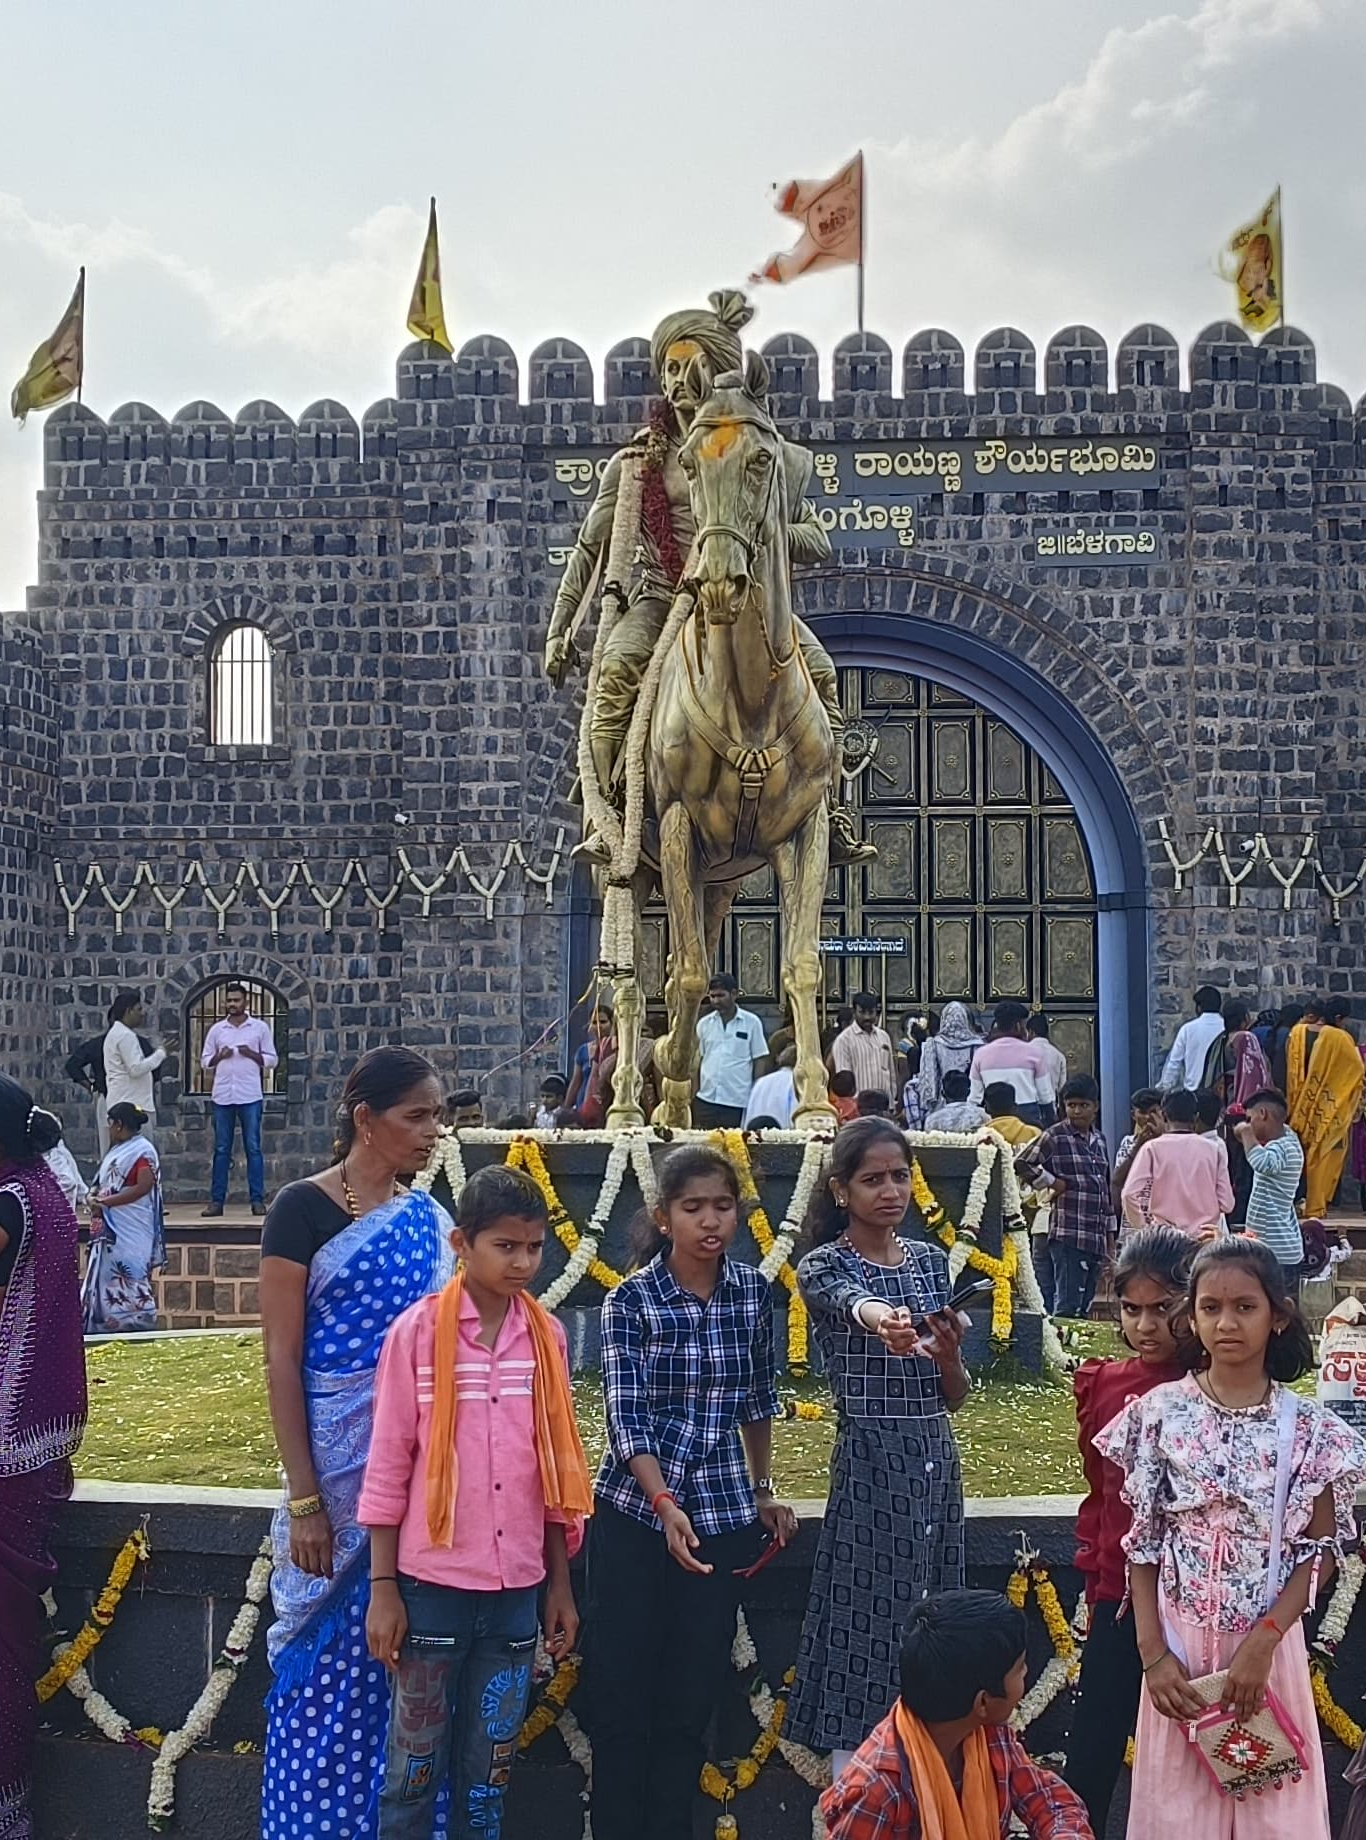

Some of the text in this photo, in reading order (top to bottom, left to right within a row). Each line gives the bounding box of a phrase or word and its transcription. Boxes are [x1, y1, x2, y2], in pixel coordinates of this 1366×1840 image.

[854, 443, 962, 492] ರಾಯಣ್ಣ
[973, 439, 1156, 476] ಶೌರ್ಯಭೂಮಿ
[818, 498, 915, 547] ಂಗೊಳ್ಳಿ
